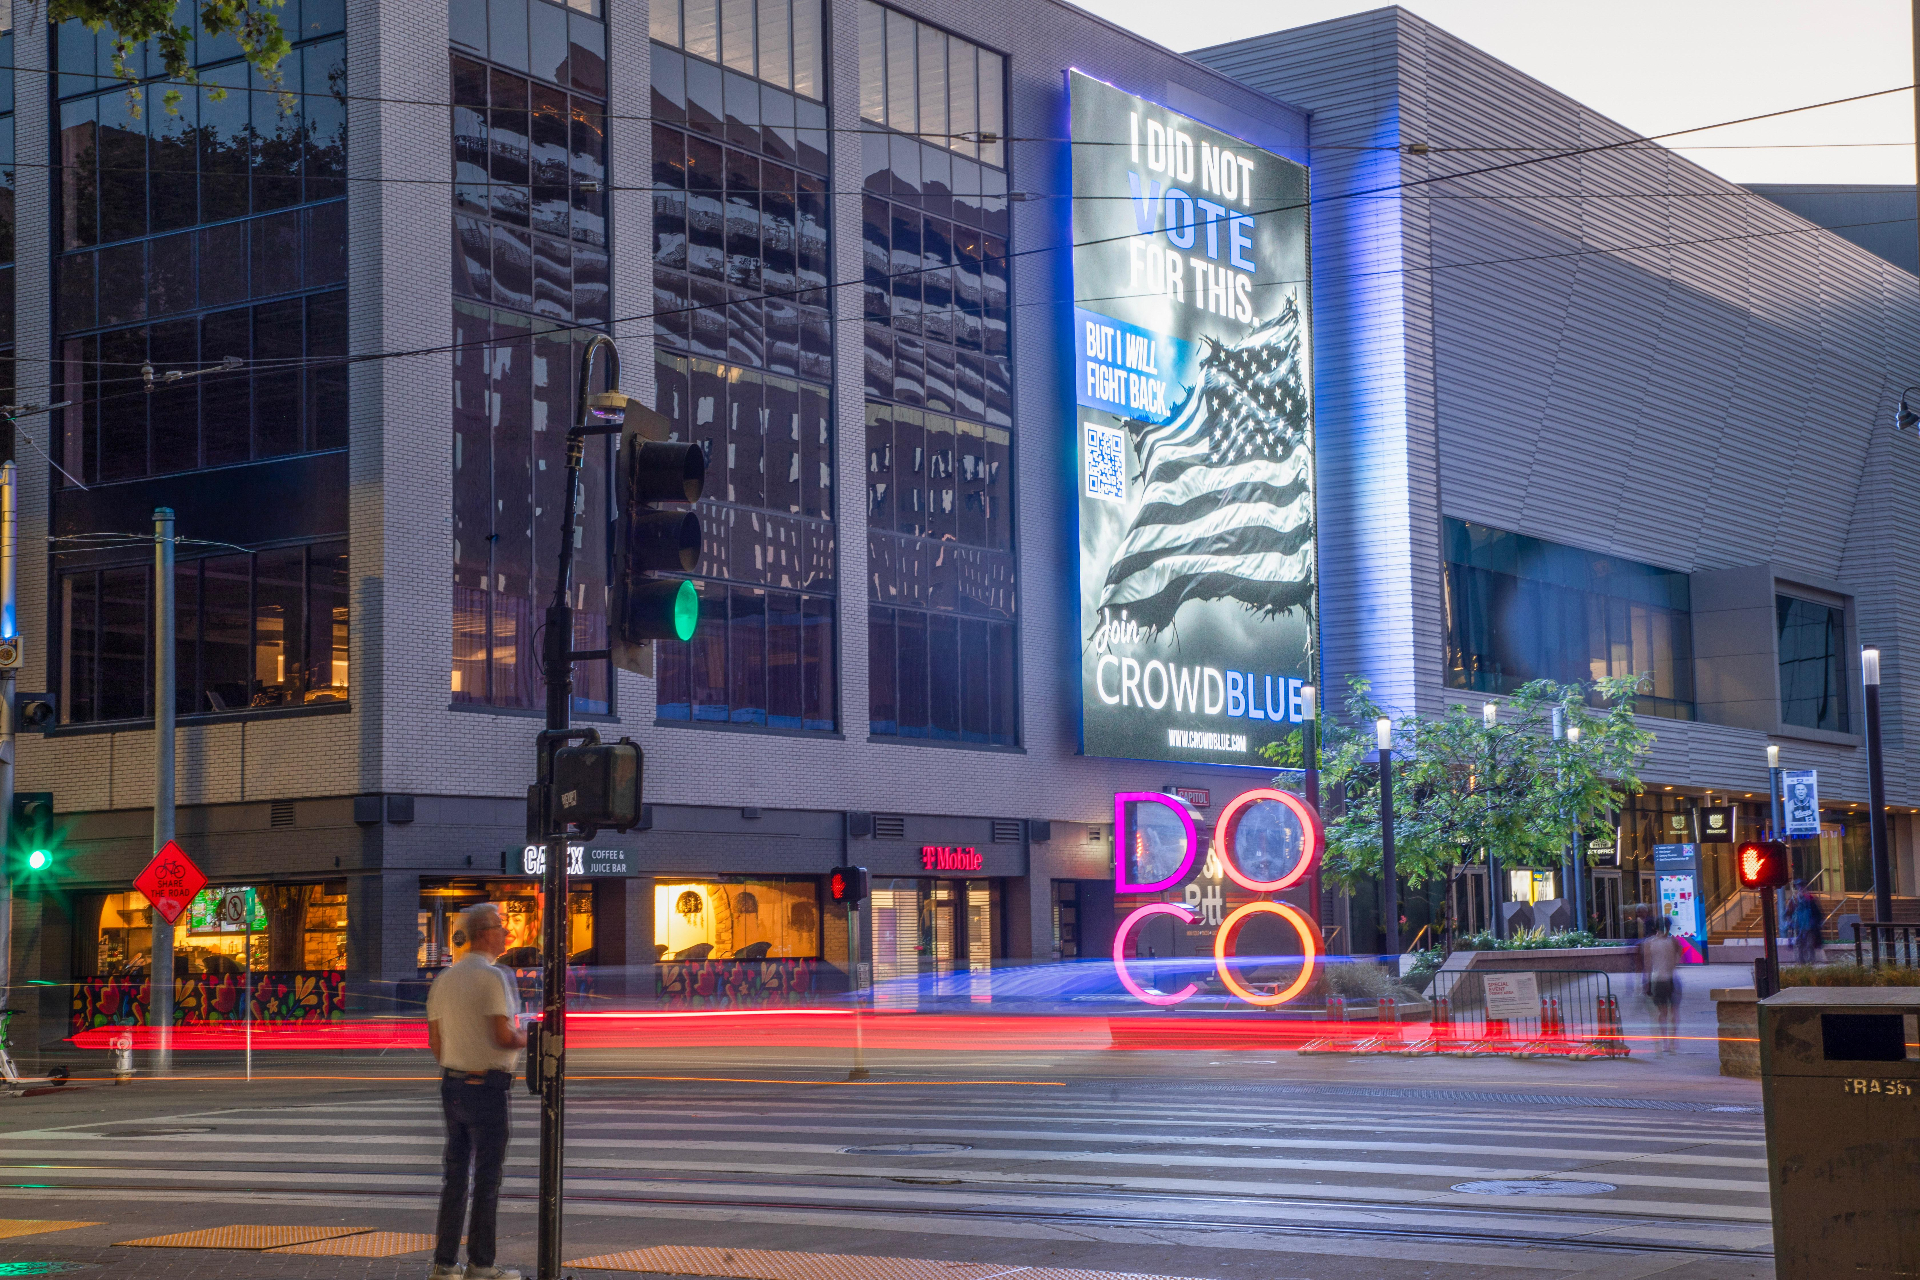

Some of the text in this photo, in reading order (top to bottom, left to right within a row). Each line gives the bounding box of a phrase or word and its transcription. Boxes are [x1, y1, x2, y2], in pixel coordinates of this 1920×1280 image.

[1130, 112, 1254, 207] I DID NOT
[1127, 170, 1256, 273] VOTE
[1129, 236, 1260, 327] FOR THIS.
[1086, 320, 1158, 375] BUT I WILL
[1086, 361, 1170, 417] FIGHT BACK.
[1096, 607, 1140, 653] Join
[1168, 729, 1246, 752] WWW.CROWDBLUE.COM
[1178, 791, 1208, 804] CAPITOL
[590, 863, 626, 873] JUICE BAR
[592, 850, 624, 859] COFFEE &
[151, 888, 190, 898] THE ROAD
[157, 879, 184, 888] SHARE
